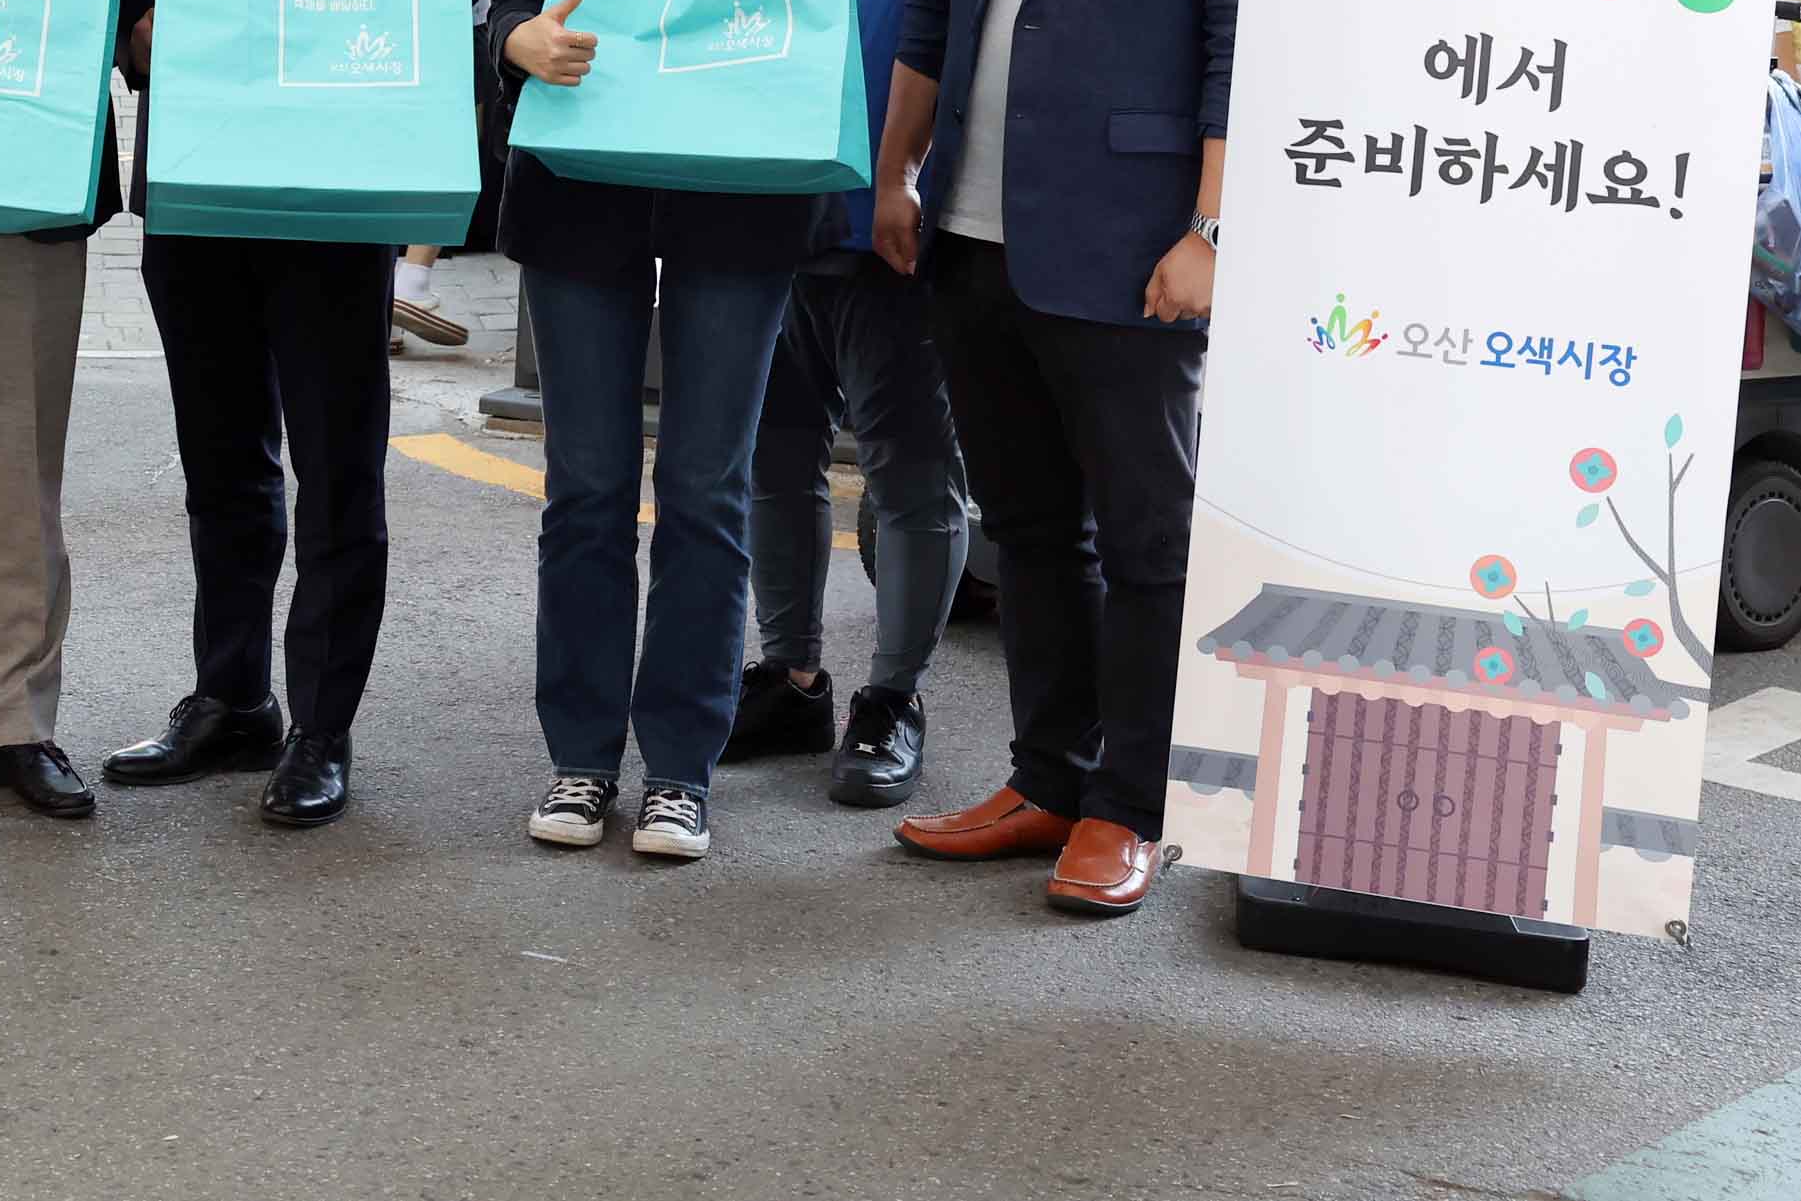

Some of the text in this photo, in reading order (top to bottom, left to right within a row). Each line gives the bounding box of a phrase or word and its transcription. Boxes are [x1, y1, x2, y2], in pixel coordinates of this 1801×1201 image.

[1423, 32, 1568, 112] 에서
[1283, 117, 1692, 220] 준비하세요!
[1395, 321, 1638, 388] 오산 오색시장
